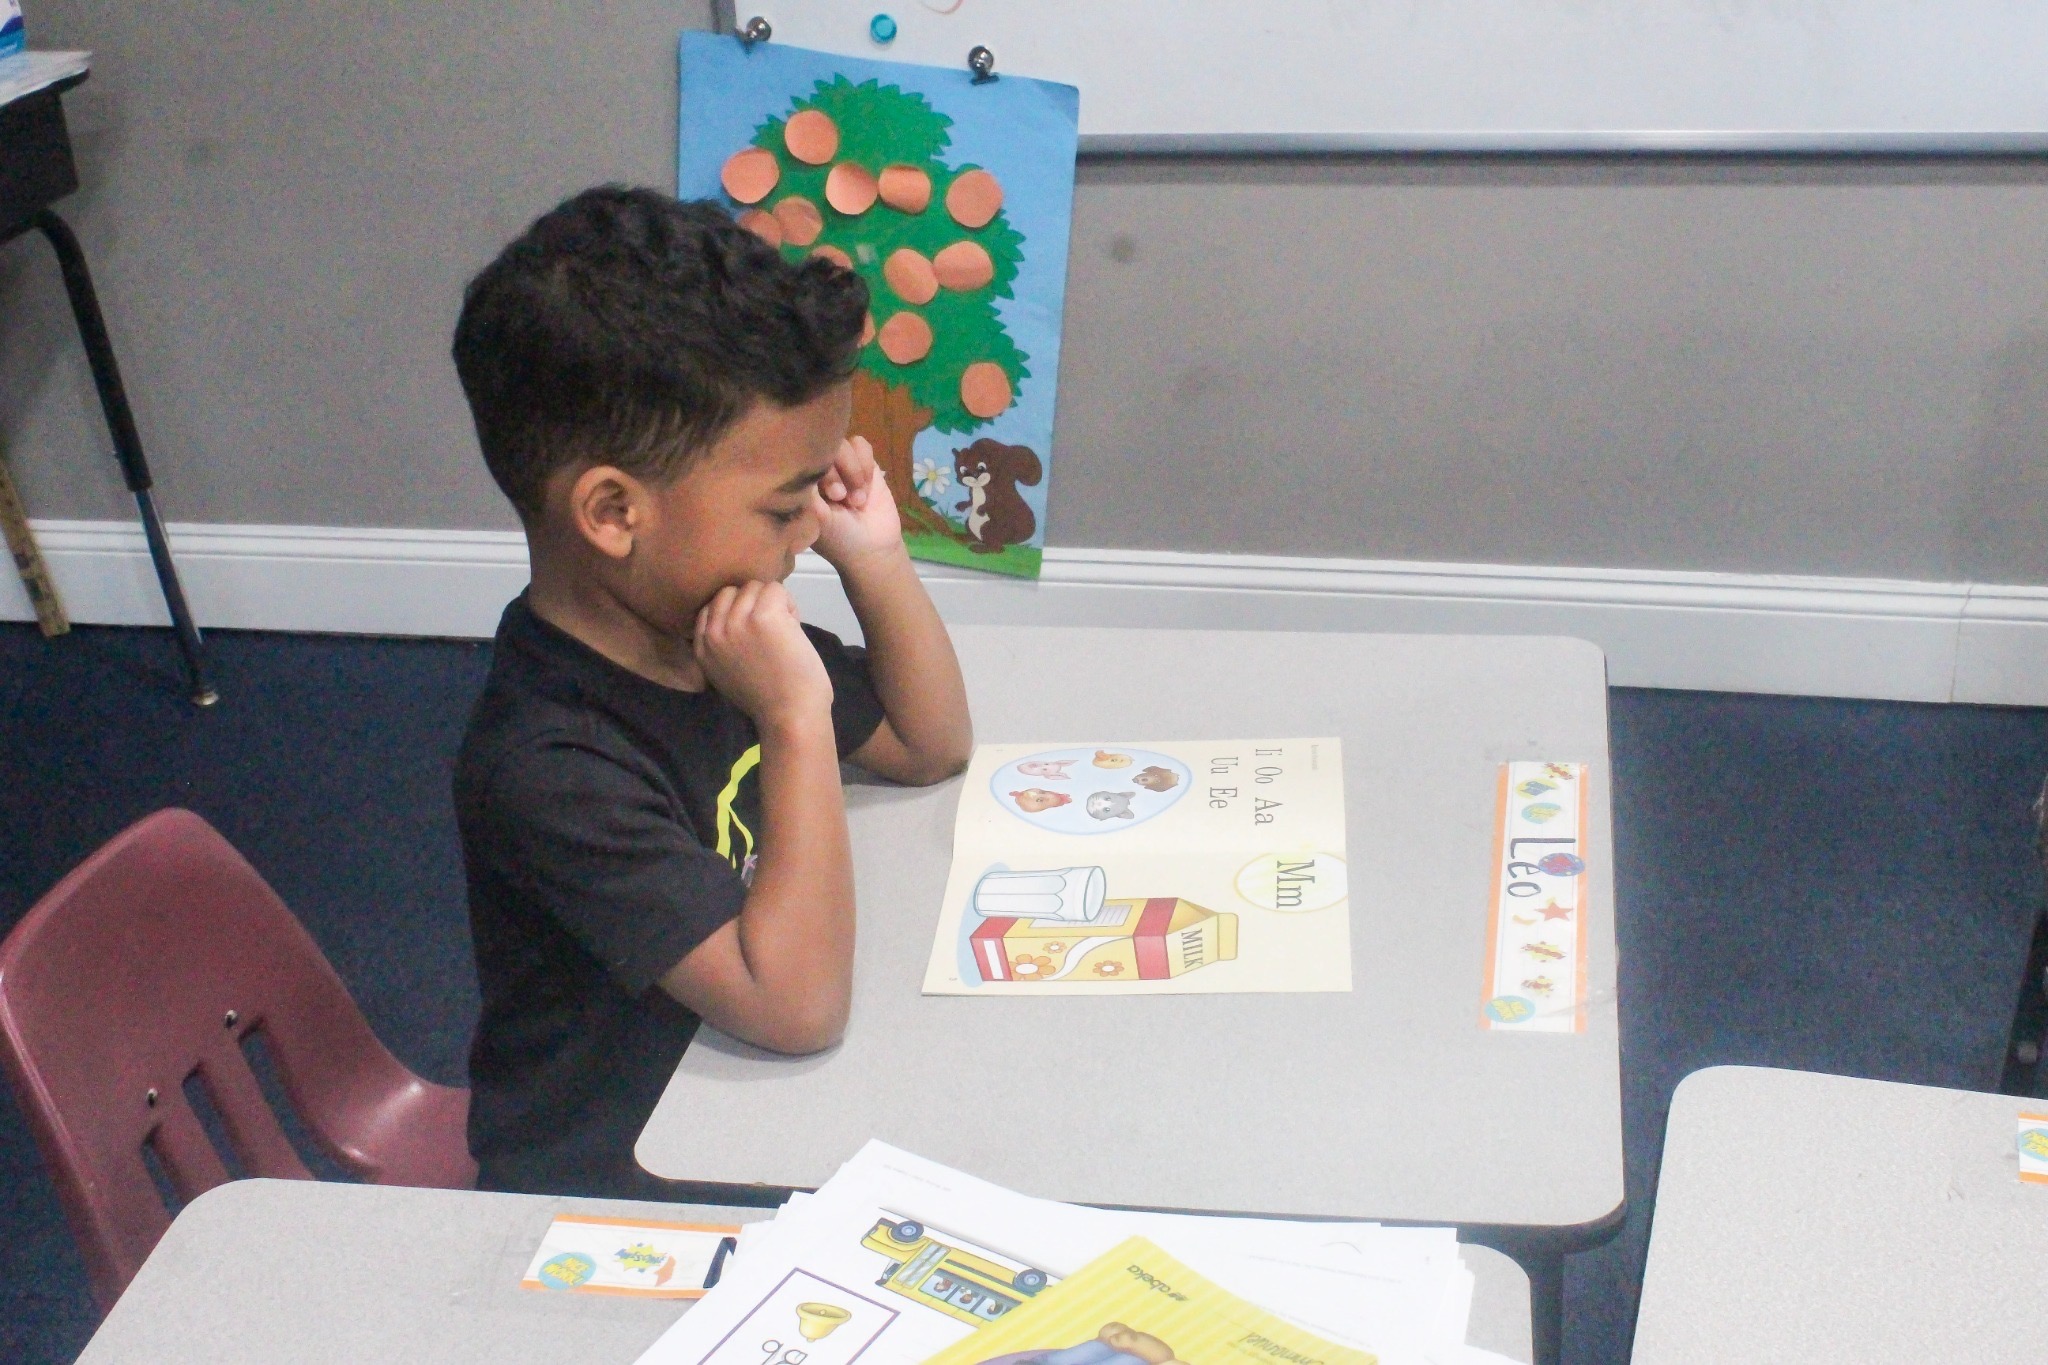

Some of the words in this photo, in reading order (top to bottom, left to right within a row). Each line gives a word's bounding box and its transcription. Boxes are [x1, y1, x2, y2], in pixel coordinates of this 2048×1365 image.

[1210, 756, 1239, 774] Uu
[1254, 766, 1283, 784] Oo
[1209, 786, 1238, 809] Ee
[1254, 797, 1284, 826] Aa
[1507, 837, 1577, 898] Leo
[1276, 859, 1315, 909] Mm
[1181, 927, 1203, 969] MILK
[1126, 1265, 1171, 1292] abeka
